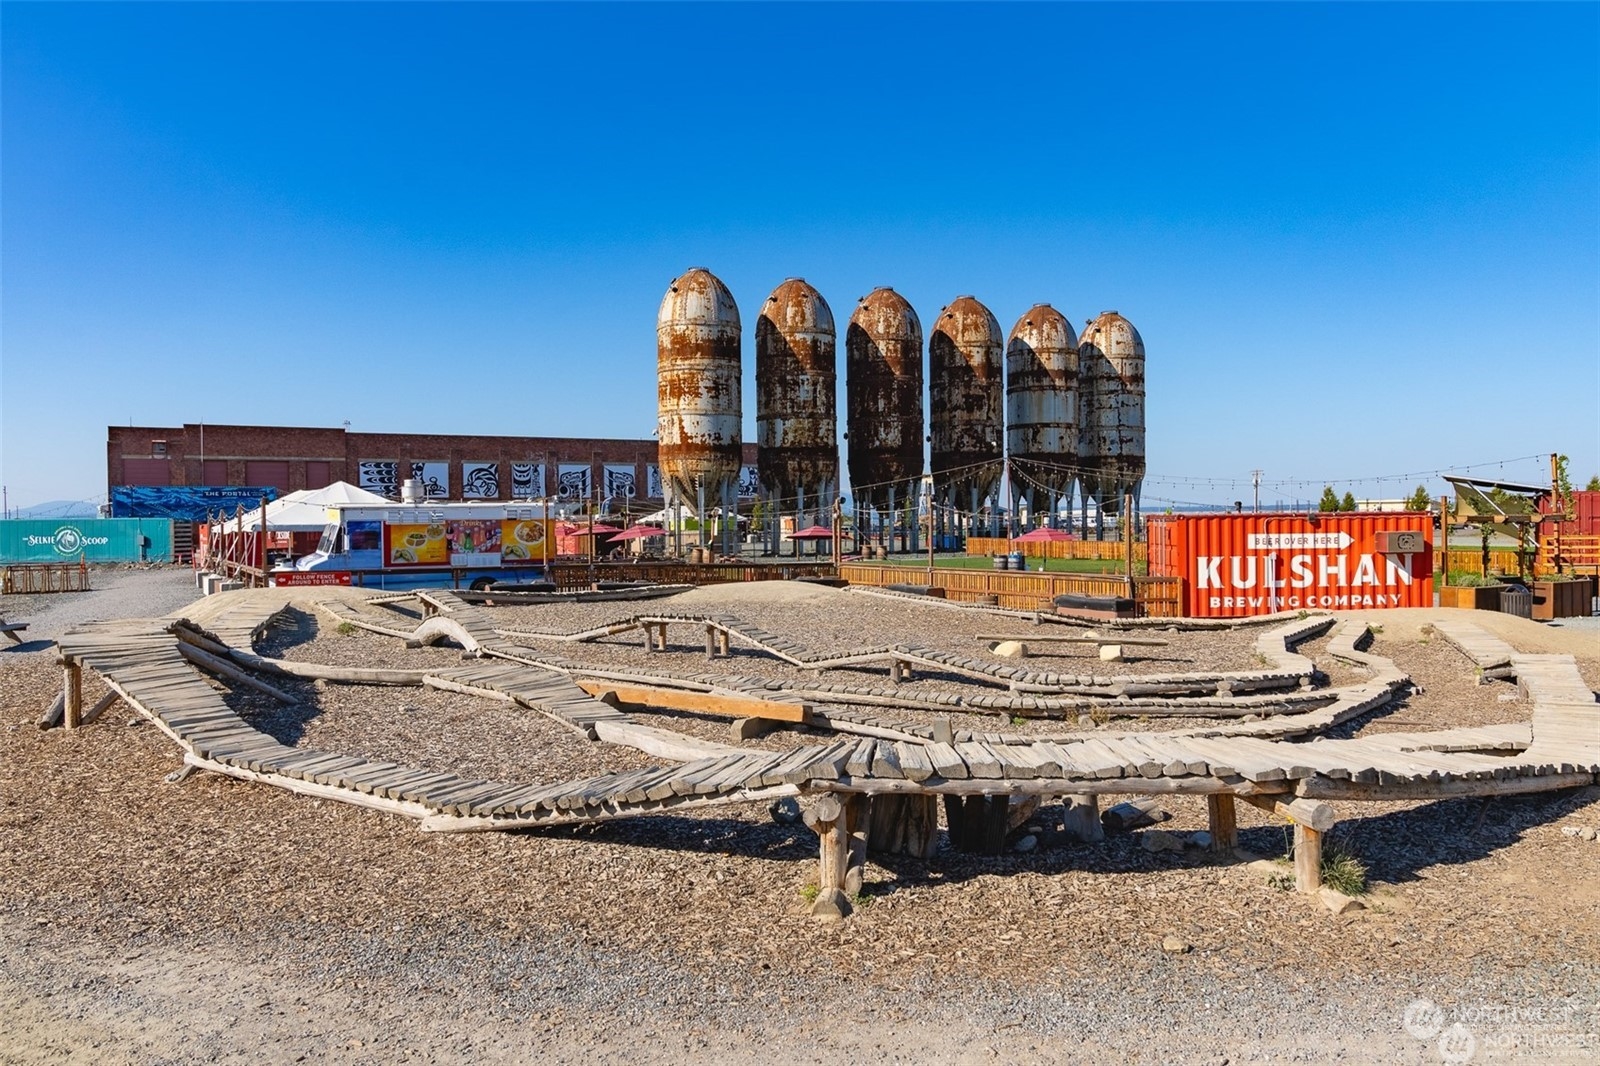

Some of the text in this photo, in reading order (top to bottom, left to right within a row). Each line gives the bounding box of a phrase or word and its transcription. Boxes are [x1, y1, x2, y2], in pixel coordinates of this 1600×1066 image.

[28, 534, 108, 546] SELKIE SCOOP
[1284, 537, 1309, 546] OVER
[1314, 536, 1339, 545] HERE
[1196, 553, 1413, 589] KULSHAN
[1210, 593, 1401, 609] BREWING COMPANY
